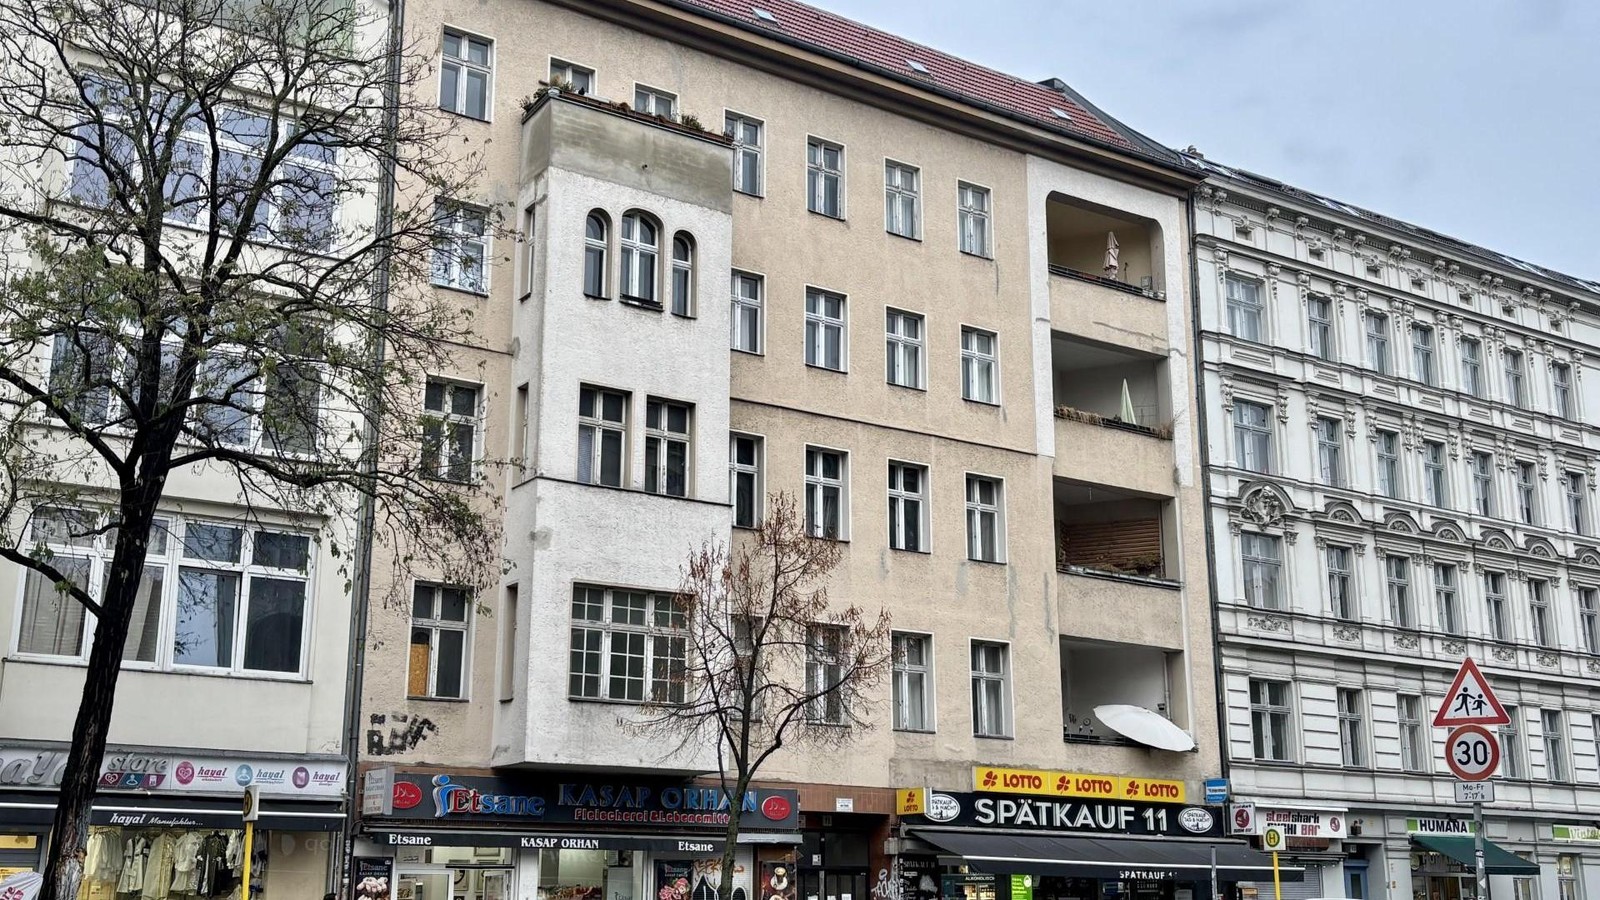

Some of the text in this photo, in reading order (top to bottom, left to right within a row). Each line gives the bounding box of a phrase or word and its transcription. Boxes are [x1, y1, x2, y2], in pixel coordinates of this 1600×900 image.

[1457, 740, 1488, 765] 30
[107, 752, 169, 772] store
[197, 766, 228, 778] hayal
[255, 769, 285, 780] hayal
[312, 771, 341, 782] hayal
[1003, 774, 1042, 790] LOTTO
[1075, 778, 1113, 794] LOTTO
[557, 783, 758, 812] KASAP ORHAN
[1144, 783, 1180, 798] LOTTO
[903, 804, 919, 812] LOTTO
[975, 798, 1168, 831] SPÄTKAUF 11
[109, 812, 147, 826] hayal
[1419, 819, 1468, 833] HUMANA
[388, 833, 432, 846] Etsane
[521, 837, 599, 849] KASAP ORHAN
[1269, 833, 1276, 844] H
[678, 841, 714, 852] Etsane
